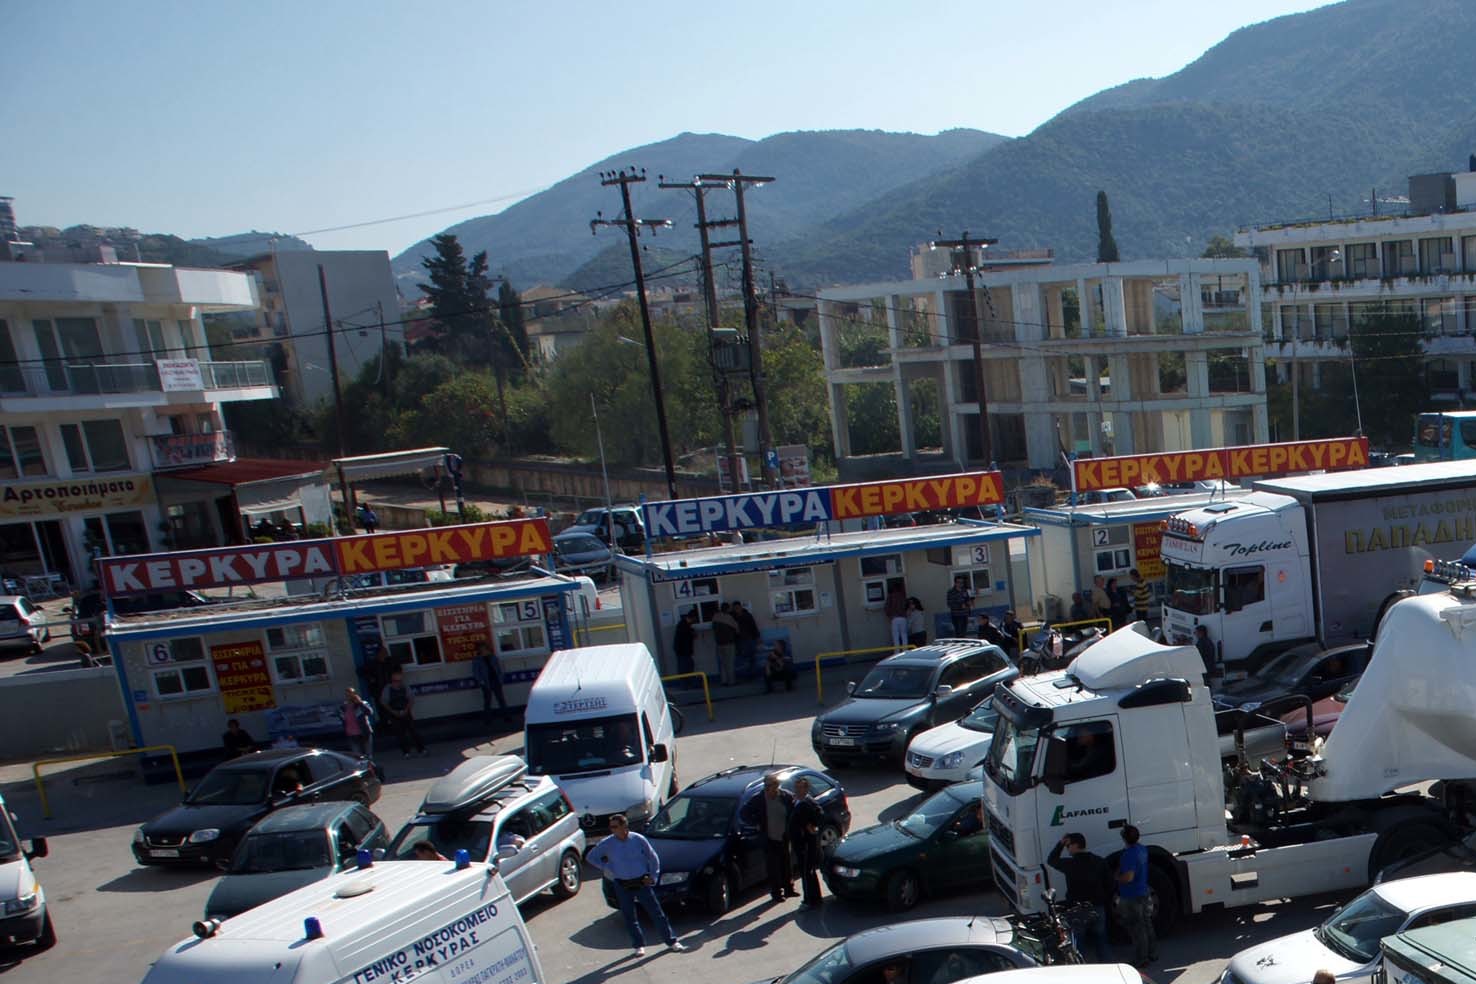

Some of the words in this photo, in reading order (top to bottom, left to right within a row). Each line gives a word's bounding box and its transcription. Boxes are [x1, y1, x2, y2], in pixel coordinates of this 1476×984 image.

[767, 451, 775, 461] P
[1079, 452, 1225, 490] ΚΕΡΚΥΡΑ
[1231, 440, 1367, 478] ΚΕΡΚΥΡΑ
[4, 480, 134, 503] Αρτοποιήματα
[647, 490, 828, 537] ΚΕΡΚΥΡΑ
[833, 472, 1000, 519] ΚΕΡΚΥΡΑ
[1097, 530, 1107, 544] 2
[974, 547, 986, 562] 3
[1223, 541, 1292, 556] Topline
[109, 546, 333, 593] ΚΕΡΚΥΡΑ
[340, 522, 548, 573] ΚΕΡΚΥΡΑ
[679, 581, 691, 597] 4
[525, 601, 536, 617] 5
[153, 643, 169, 662] 6
[1060, 806, 1110, 818] LAFARGE
[413, 903, 498, 958] ΝΟΣΟΚΟΜΕΙΟ
